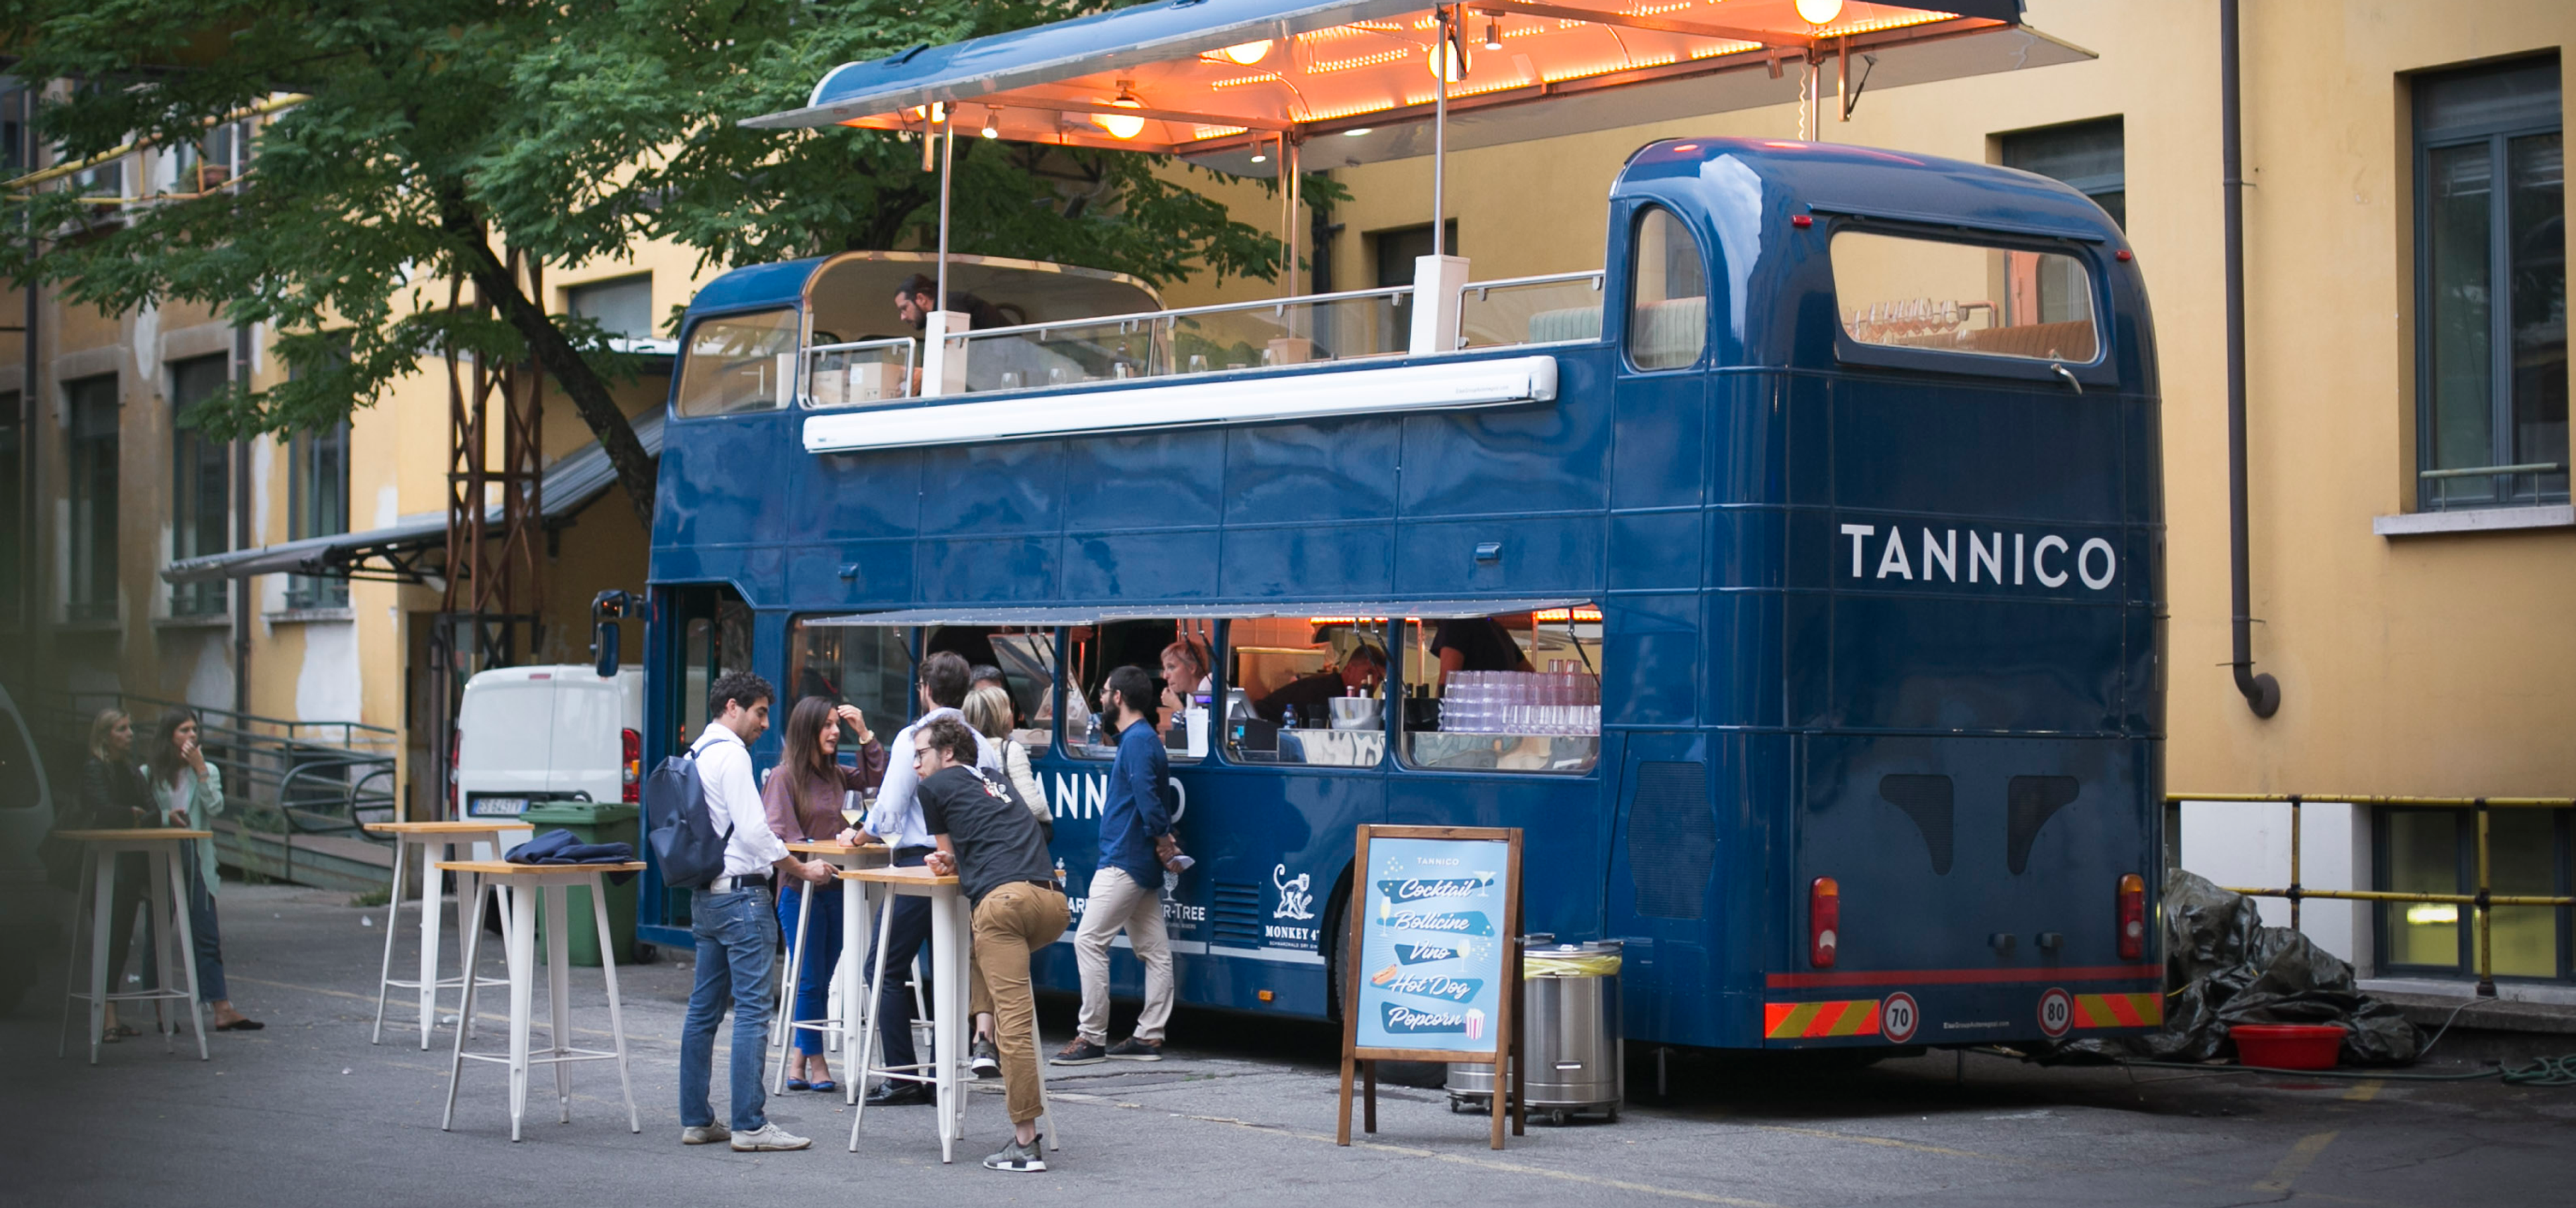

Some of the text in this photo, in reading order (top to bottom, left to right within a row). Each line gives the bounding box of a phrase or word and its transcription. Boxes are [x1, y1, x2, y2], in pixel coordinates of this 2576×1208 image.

[1841, 523, 2116, 590] TANNICO
[1417, 857, 1460, 866] TANNICO
[1399, 878, 1475, 899] Cocktail
[1161, 903, 1205, 921] R-TREE
[1394, 910, 1470, 930] Bollicine
[1265, 925, 1309, 940] MONKEY
[1409, 940, 1451, 960] Vino
[1388, 972, 1470, 999] Hot Dog
[1388, 1007, 1462, 1030] Popcorn
[1892, 1008, 1909, 1027] 70
[2048, 1003, 2064, 1021] 80
